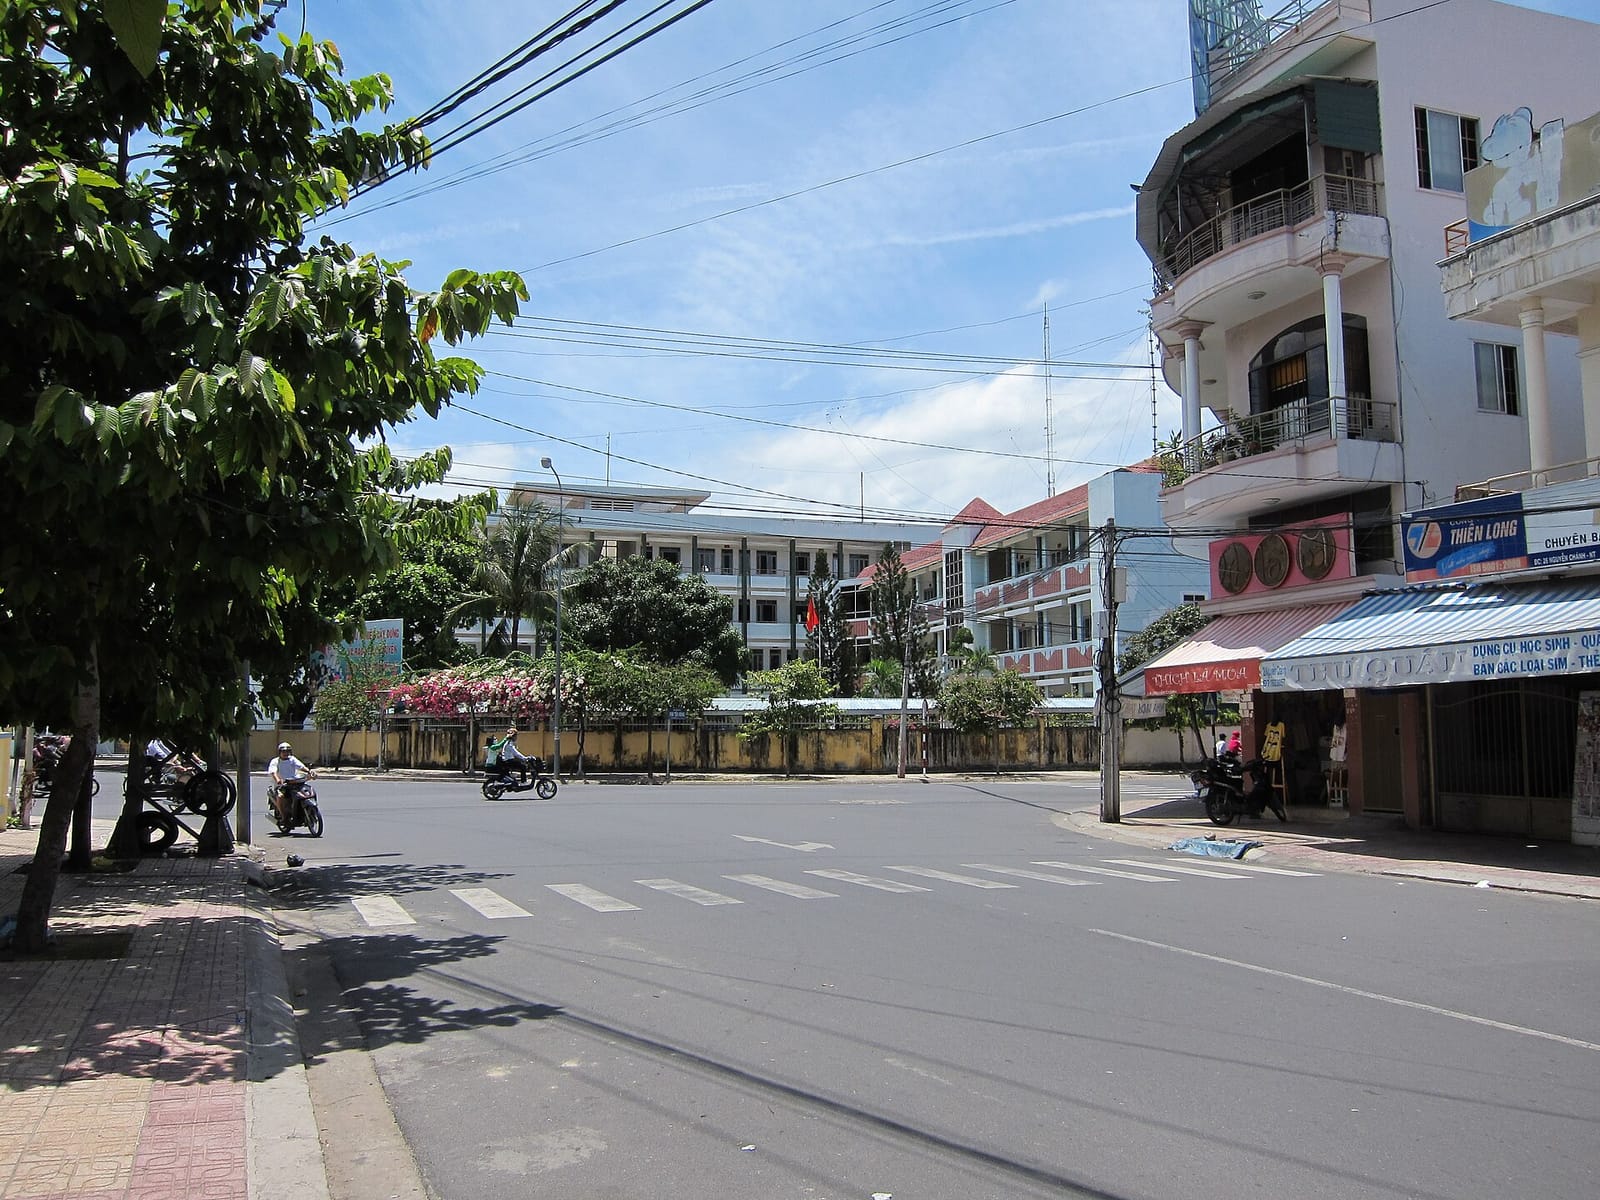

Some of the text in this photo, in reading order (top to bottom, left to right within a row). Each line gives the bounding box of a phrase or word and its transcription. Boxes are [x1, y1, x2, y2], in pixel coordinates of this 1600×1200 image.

[1450, 519, 1518, 545] THIÊN LONG
[1545, 532, 1587, 549] CHUYÊN
[1473, 643, 1500, 659] DỤNG
[1503, 642, 1516, 656] CỤ
[1520, 640, 1542, 655] HỌC
[1545, 636, 1570, 651] SINH
[1213, 667, 1248, 681] MUA
[1473, 660, 1495, 676] BÁN
[1497, 658, 1517, 674] CÁC
[1521, 659, 1544, 673] LOẠI
[1547, 656, 1568, 671] SIM
